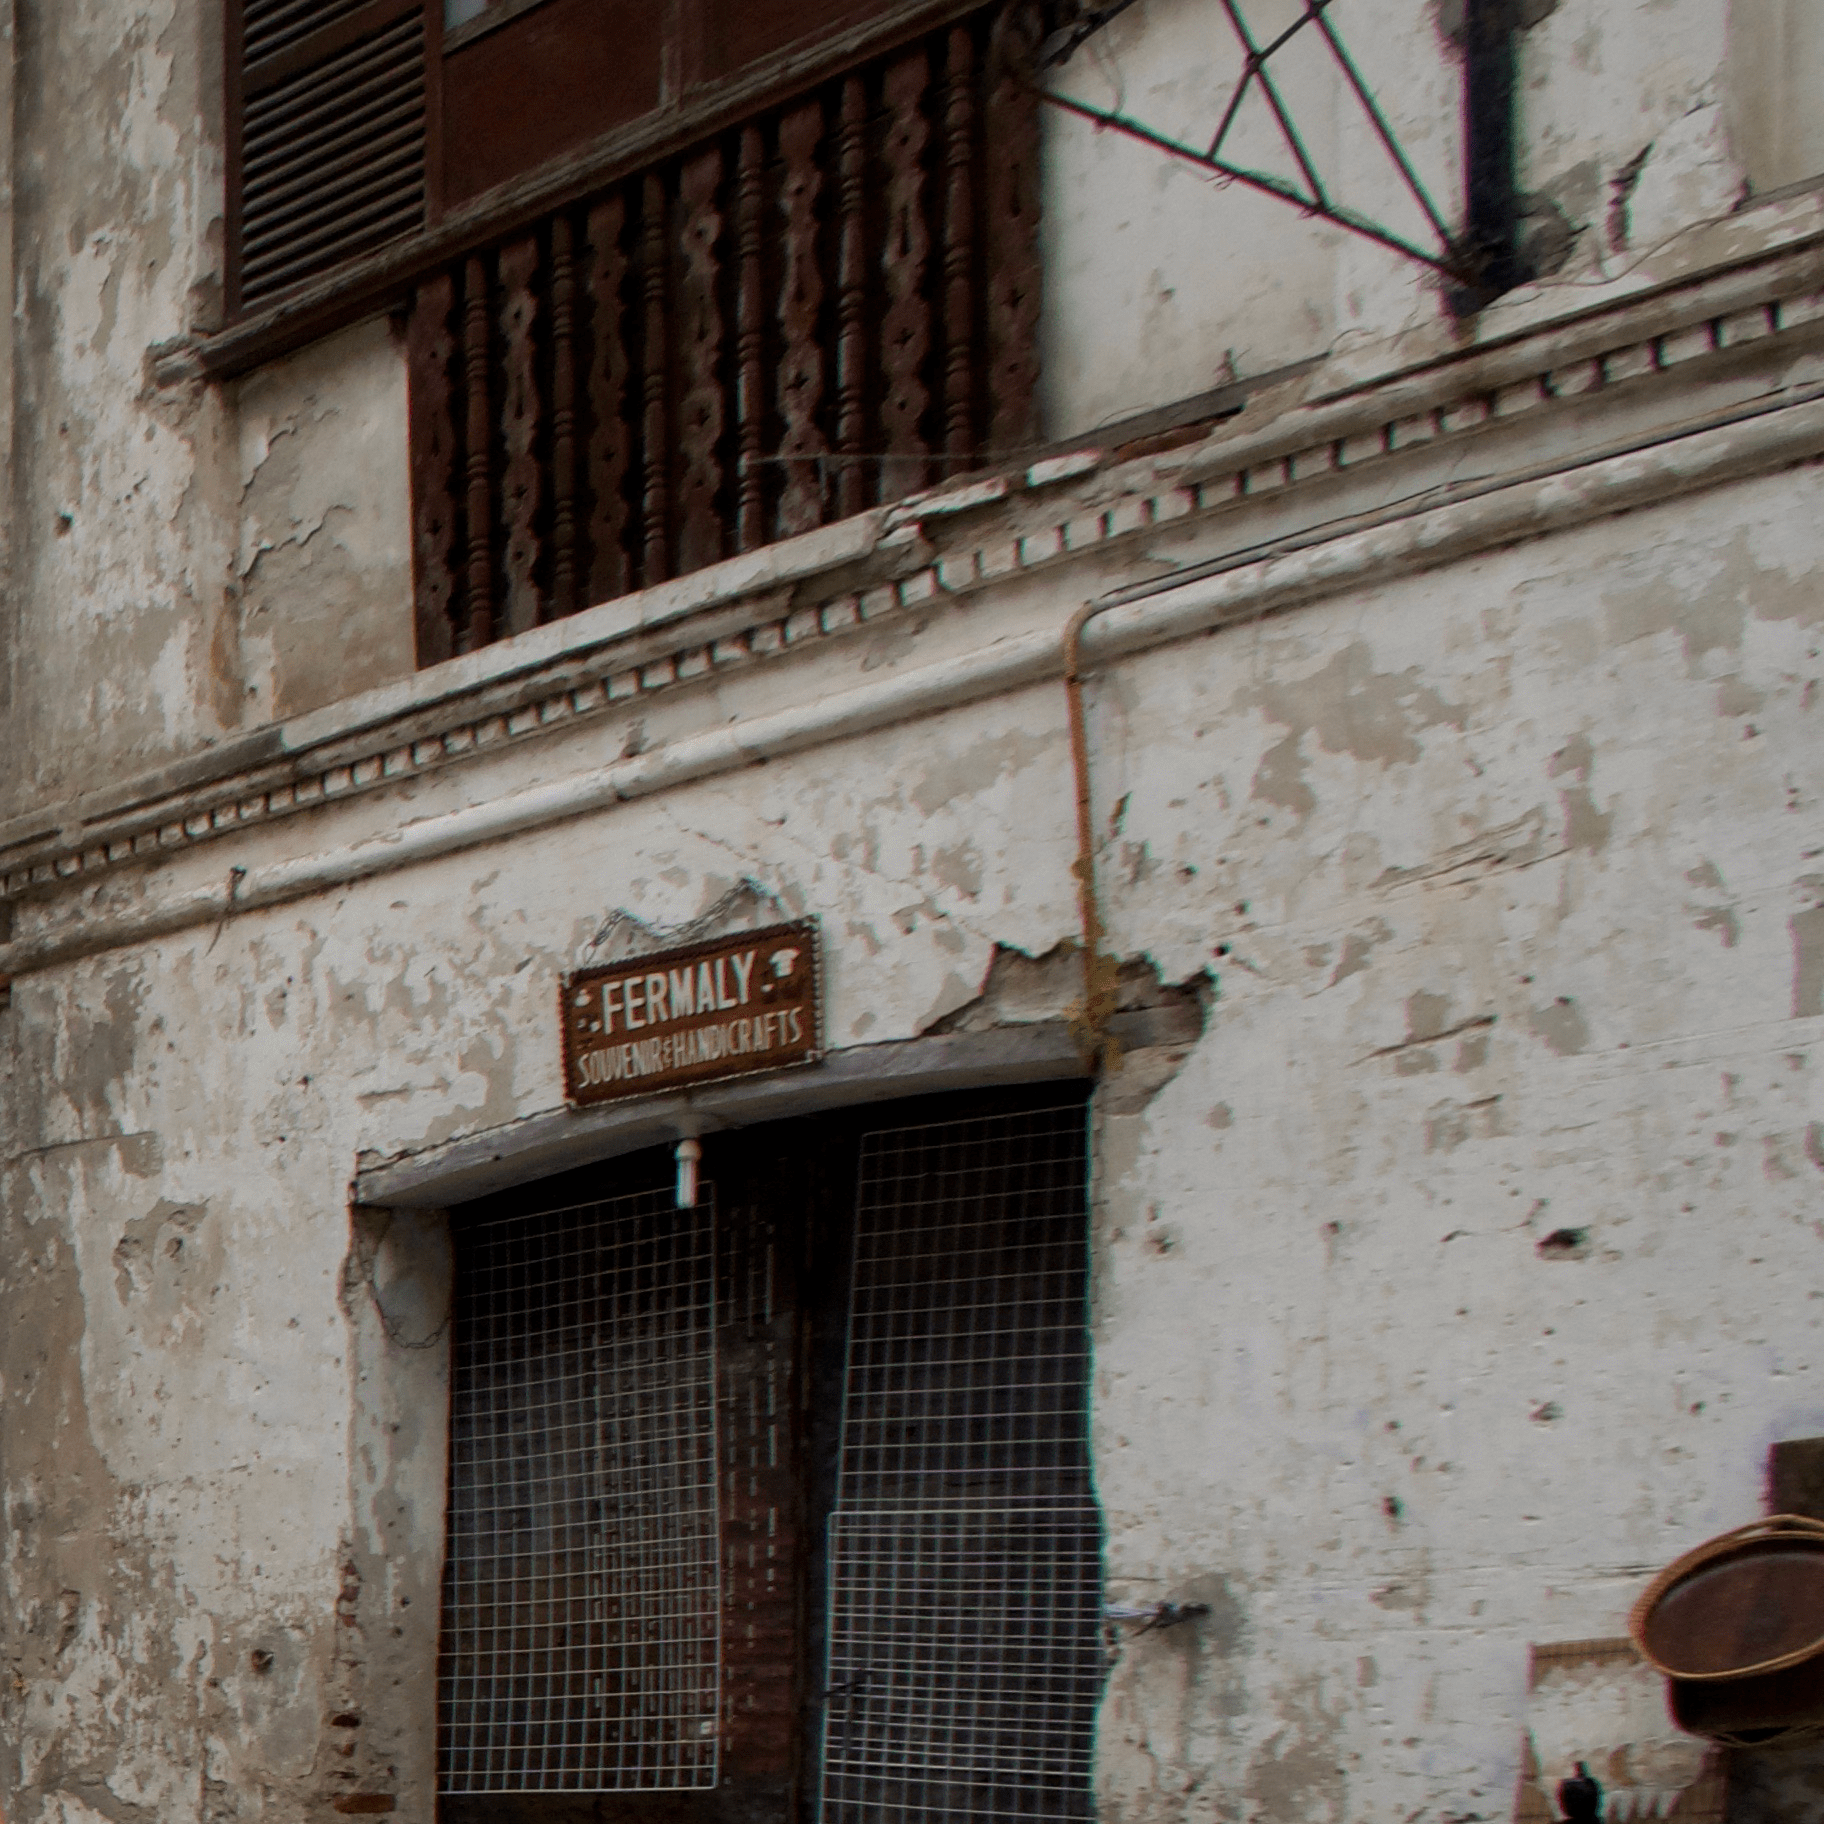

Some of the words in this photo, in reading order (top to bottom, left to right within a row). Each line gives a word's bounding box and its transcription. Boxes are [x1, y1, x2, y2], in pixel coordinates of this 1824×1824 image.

[602, 950, 757, 1035] FERMALY
[577, 1036, 664, 1088] SOUVENIR
[672, 1006, 802, 1069] HANDICRAFTS
